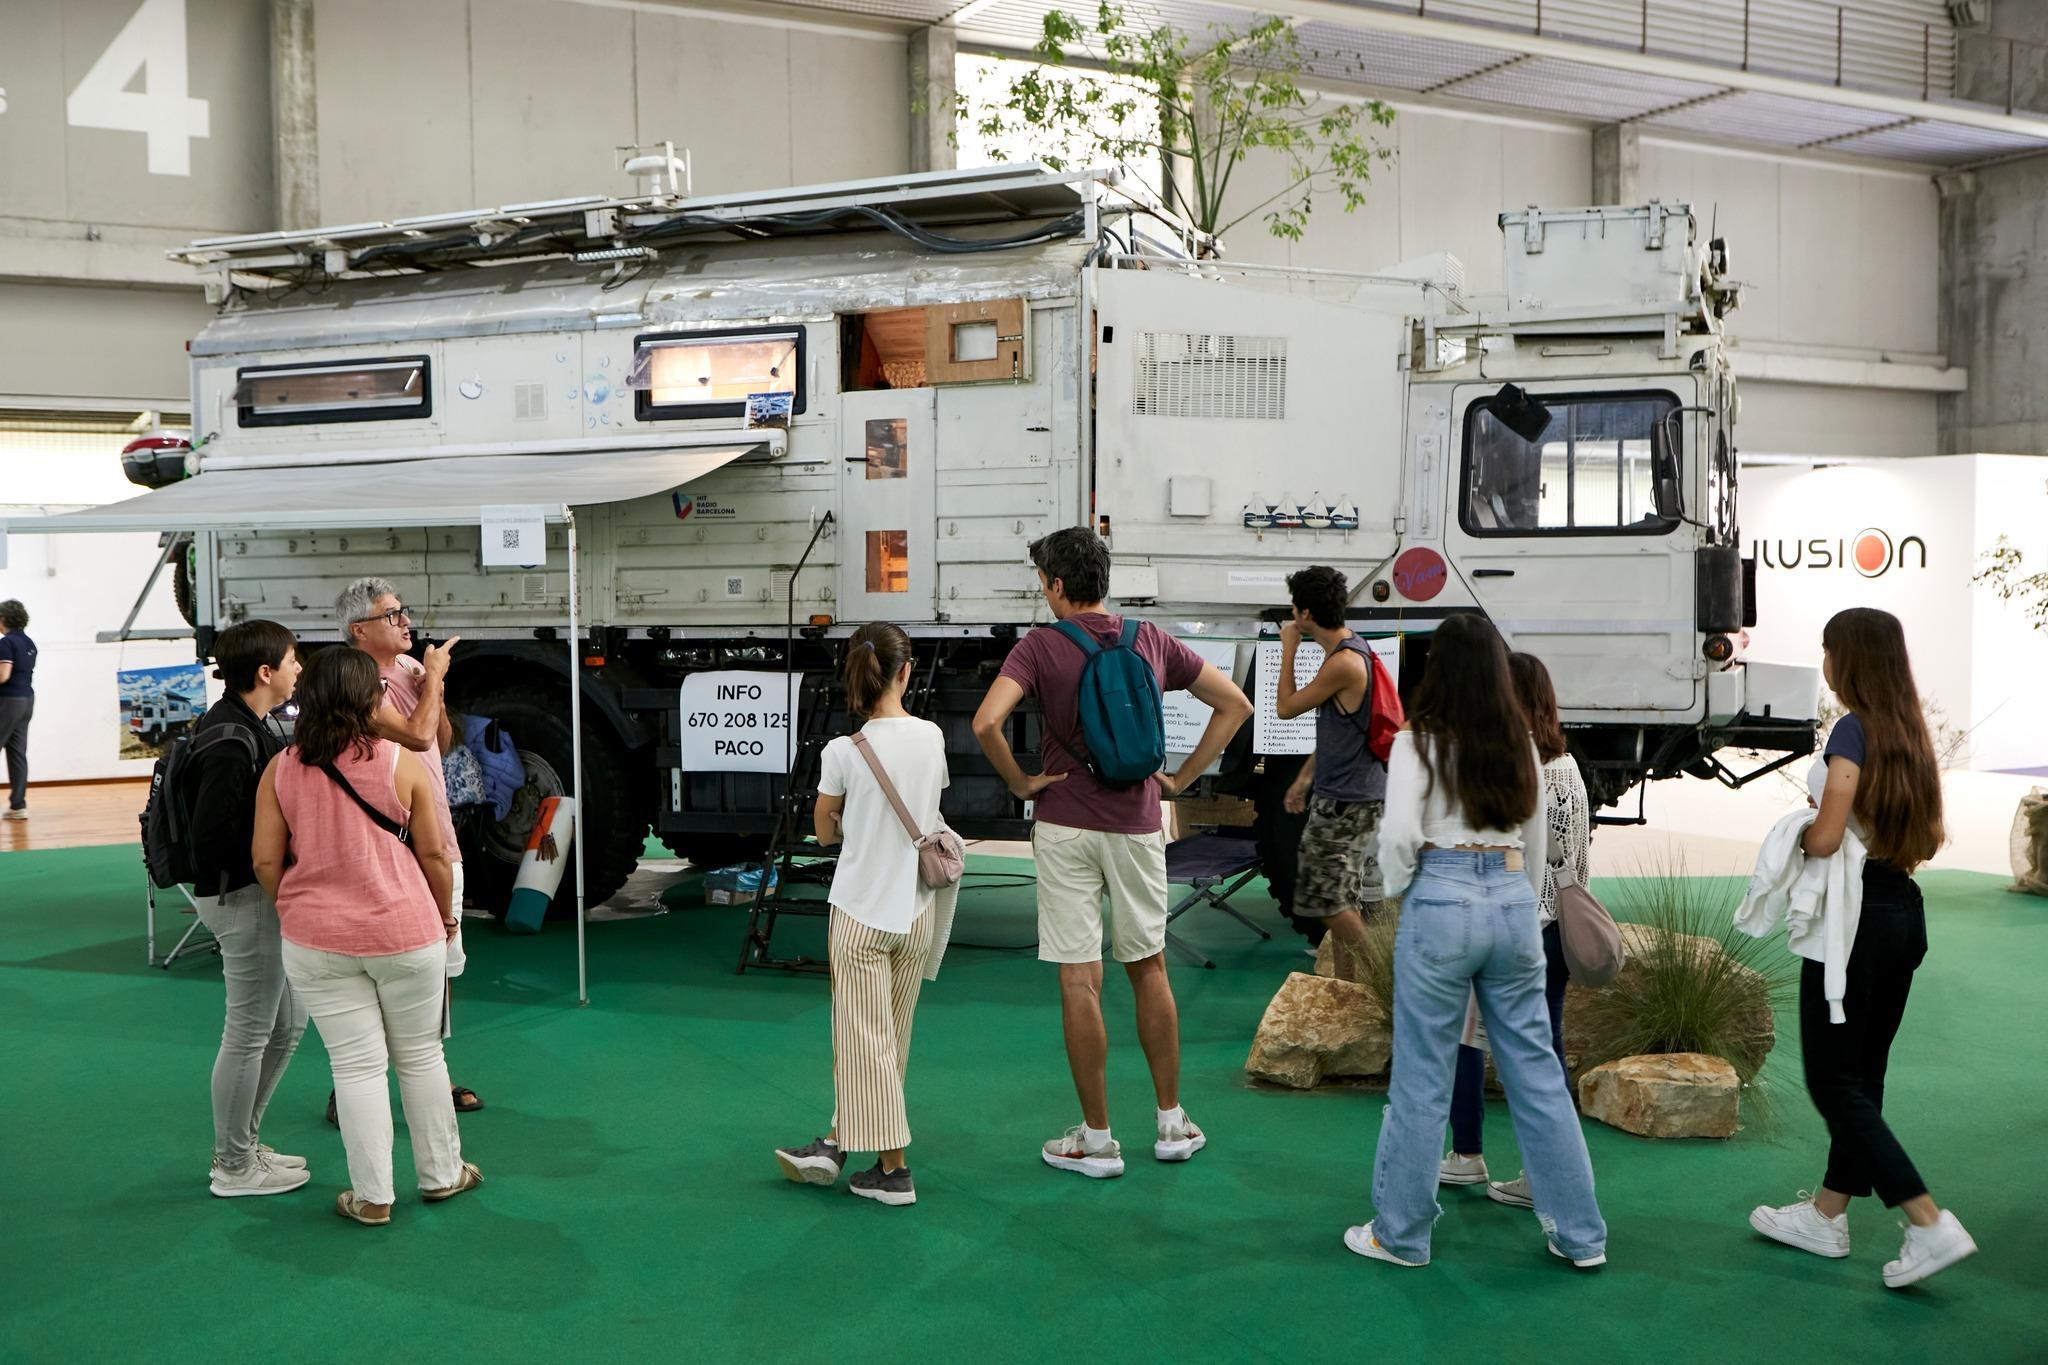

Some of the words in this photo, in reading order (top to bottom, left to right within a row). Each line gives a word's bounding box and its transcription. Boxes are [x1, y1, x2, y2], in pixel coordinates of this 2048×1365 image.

[66, 0, 210, 177] 4
[717, 685, 762, 700] INFO
[688, 712, 718, 728] 670
[724, 712, 757, 728] 208
[763, 712, 790, 728] 125
[714, 740, 764, 756] PACO
